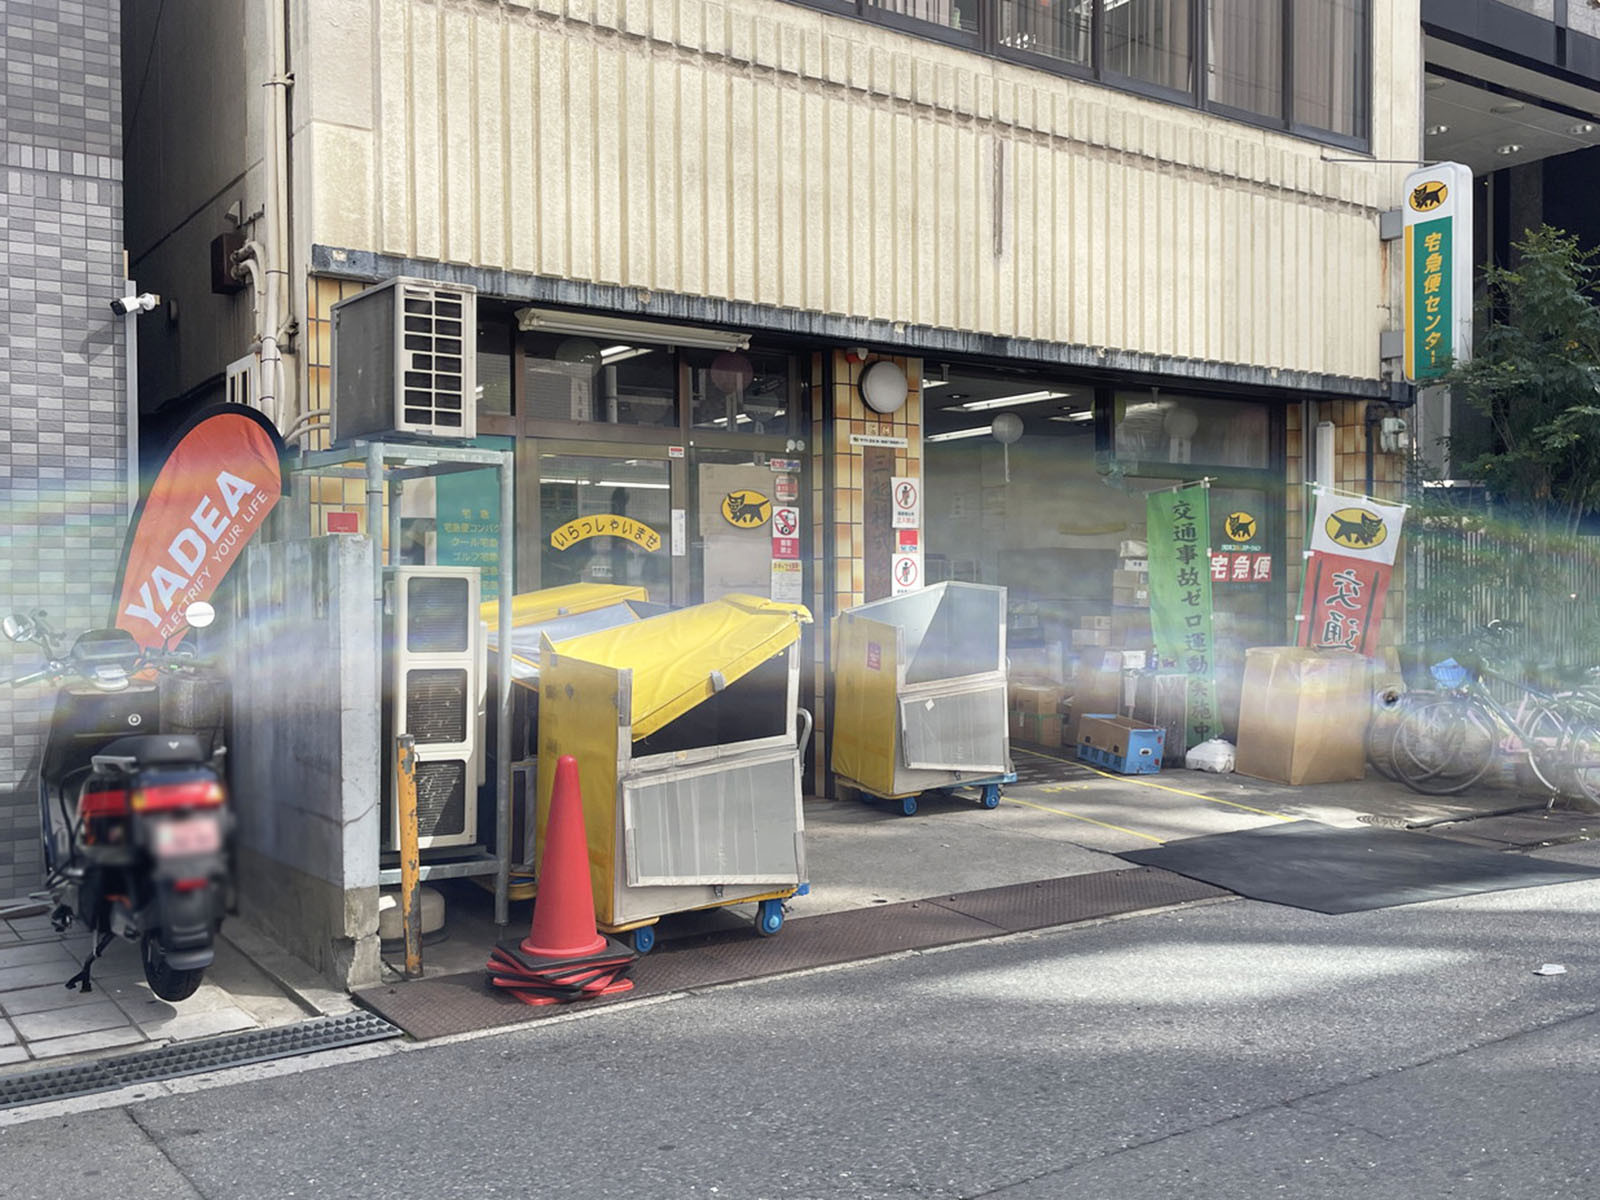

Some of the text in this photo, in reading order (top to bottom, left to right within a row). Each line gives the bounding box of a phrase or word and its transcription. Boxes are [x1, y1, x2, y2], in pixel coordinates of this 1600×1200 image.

[1424, 231, 1442, 364] 宅急便センター
[125, 471, 256, 629] YADEA
[160, 490, 268, 640] ELECTRIFY YOUR LIFE
[554, 518, 658, 549] いらっしゃいませ
[1210, 554, 1271, 579] 宅急便
